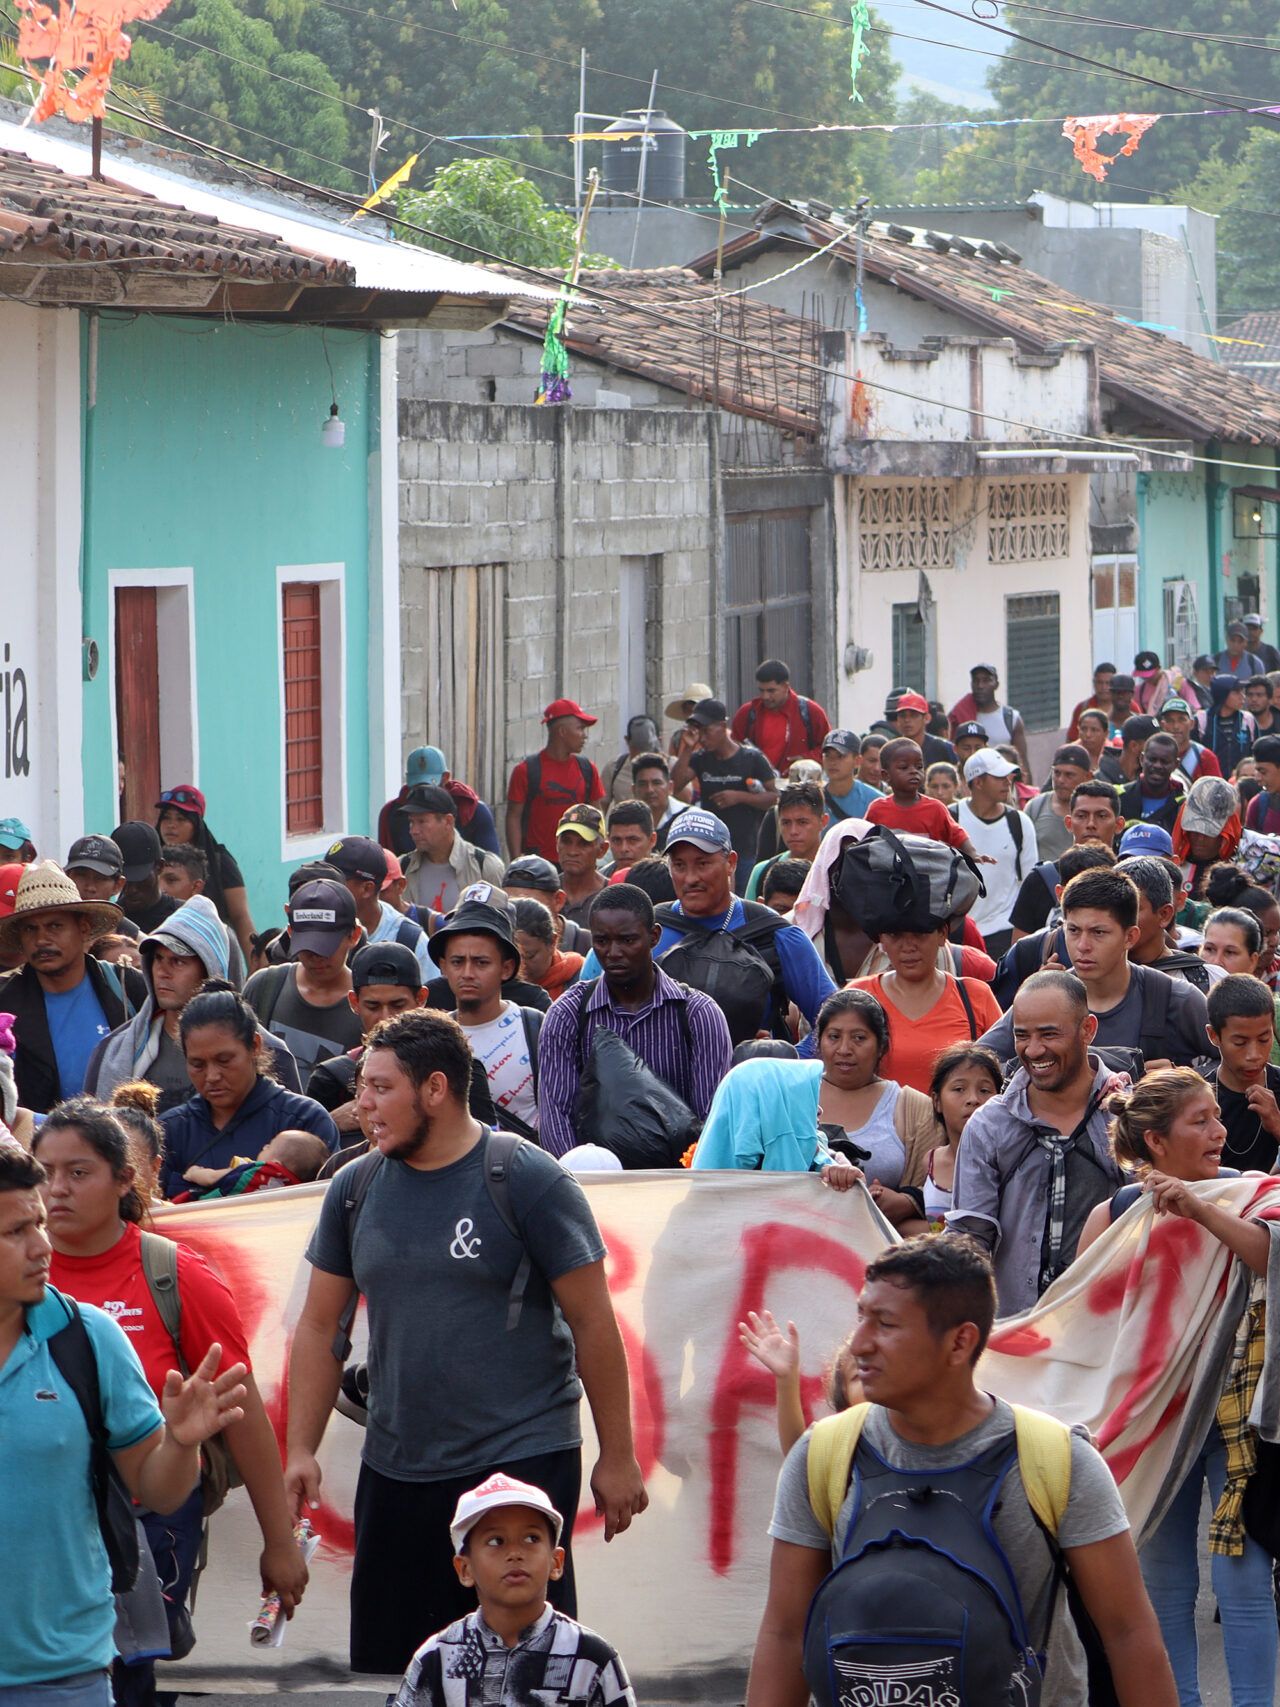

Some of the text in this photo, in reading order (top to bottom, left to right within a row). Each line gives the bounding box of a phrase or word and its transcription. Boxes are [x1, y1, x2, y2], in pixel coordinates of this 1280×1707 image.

[0, 642, 30, 778] ia
[683, 814, 715, 827] ANTONIO
[295, 911, 324, 920] Timberland
[482, 1030, 517, 1062] hampion
